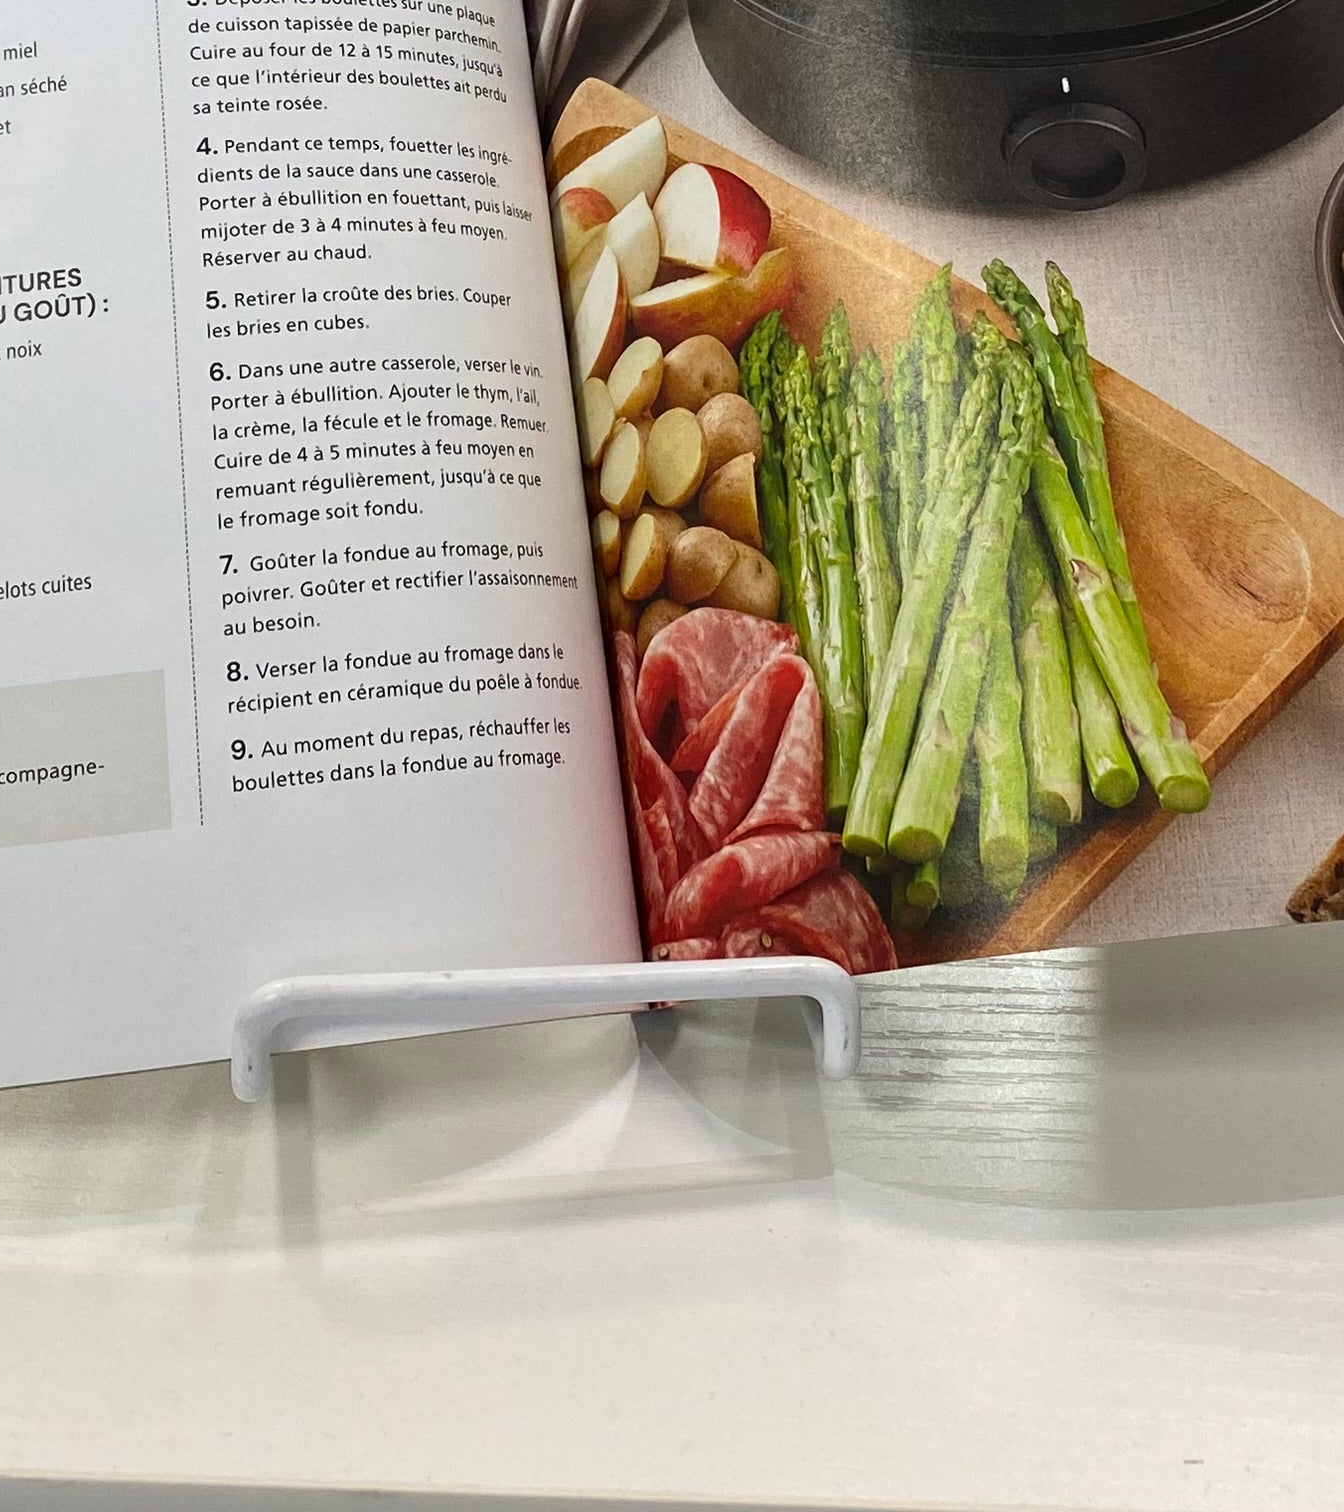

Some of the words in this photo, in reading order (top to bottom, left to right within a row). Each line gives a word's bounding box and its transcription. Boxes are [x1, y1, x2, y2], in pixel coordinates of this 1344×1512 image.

[192, 102, 211, 115] sa
[216, 97, 271, 114] teinte
[275, 95, 328, 111] rosée.
[13, 292, 96, 322] GOÛT)
[6, 339, 42, 360] noix
[41, 574, 92, 595] cuites
[230, 739, 254, 761] 9.
[261, 740, 288, 758] Au
[294, 731, 375, 754] moment
[380, 727, 404, 745] du
[410, 726, 463, 745] repas,
[469, 716, 550, 738] réchauffer
[553, 717, 571, 734] les
[232, 769, 325, 793] boulettes
[330, 763, 375, 782] dans
[380, 759, 397, 777] la
[401, 753, 468, 775] fondue
[473, 754, 494, 769] au
[497, 748, 565, 769] fromage.
